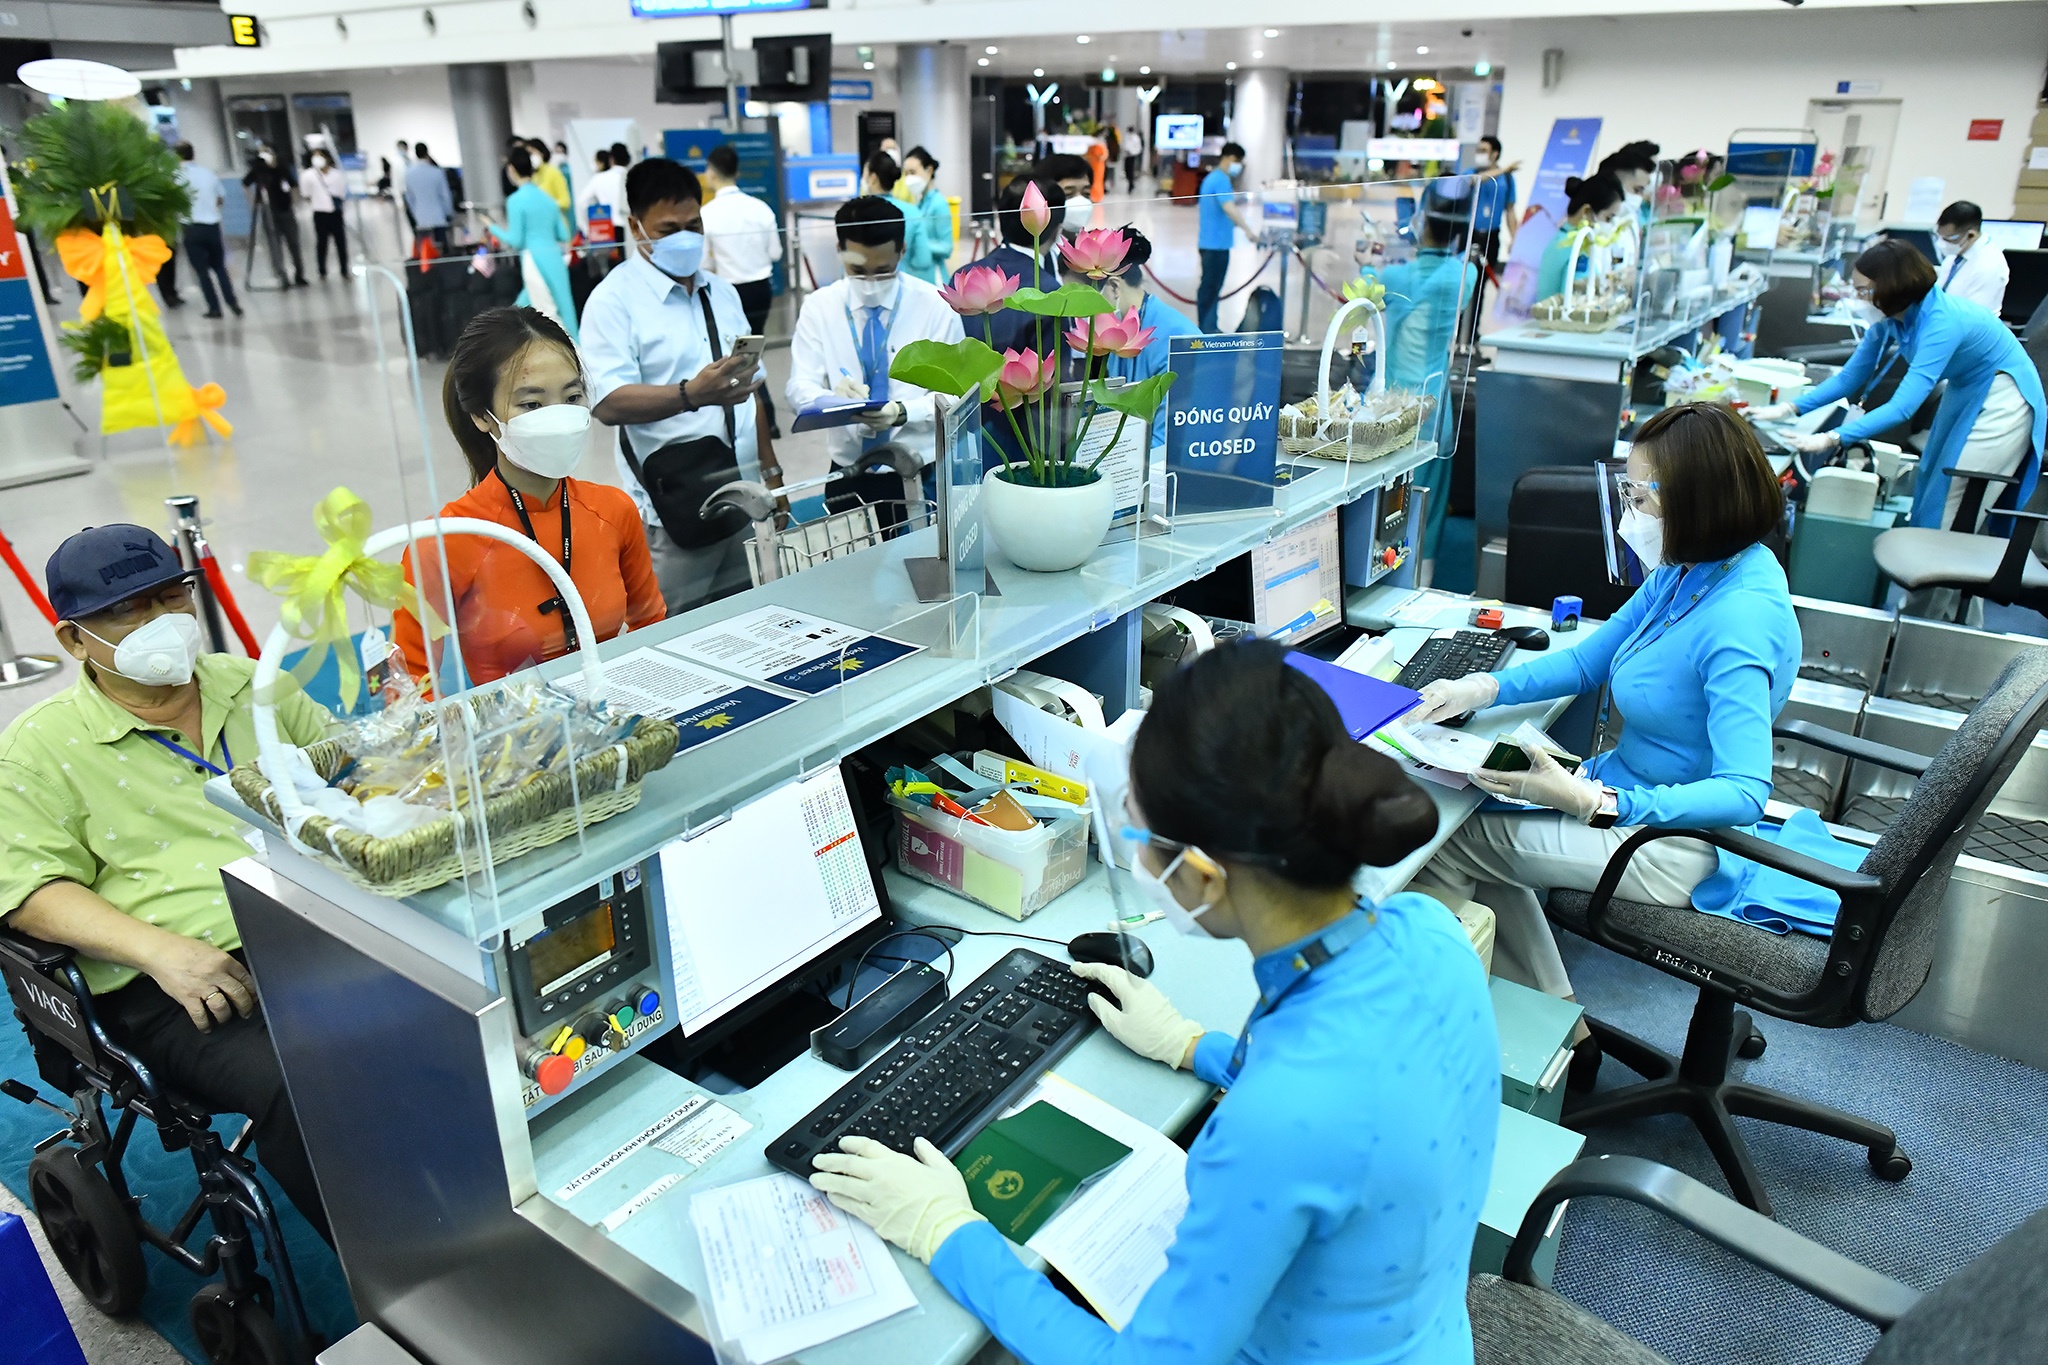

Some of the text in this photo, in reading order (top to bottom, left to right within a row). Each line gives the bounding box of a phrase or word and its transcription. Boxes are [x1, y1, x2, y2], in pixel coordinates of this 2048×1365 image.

[233, 16, 256, 44] E
[1173, 406, 1224, 427] ĐÓNG
[1188, 438, 1256, 458] CLOSED
[958, 521, 979, 563] CLOSED
[97, 552, 159, 586] PUMA
[20, 976, 77, 1029] VIAGS
[583, 1047, 603, 1065] SAU
[623, 1140, 637, 1152] KHI
